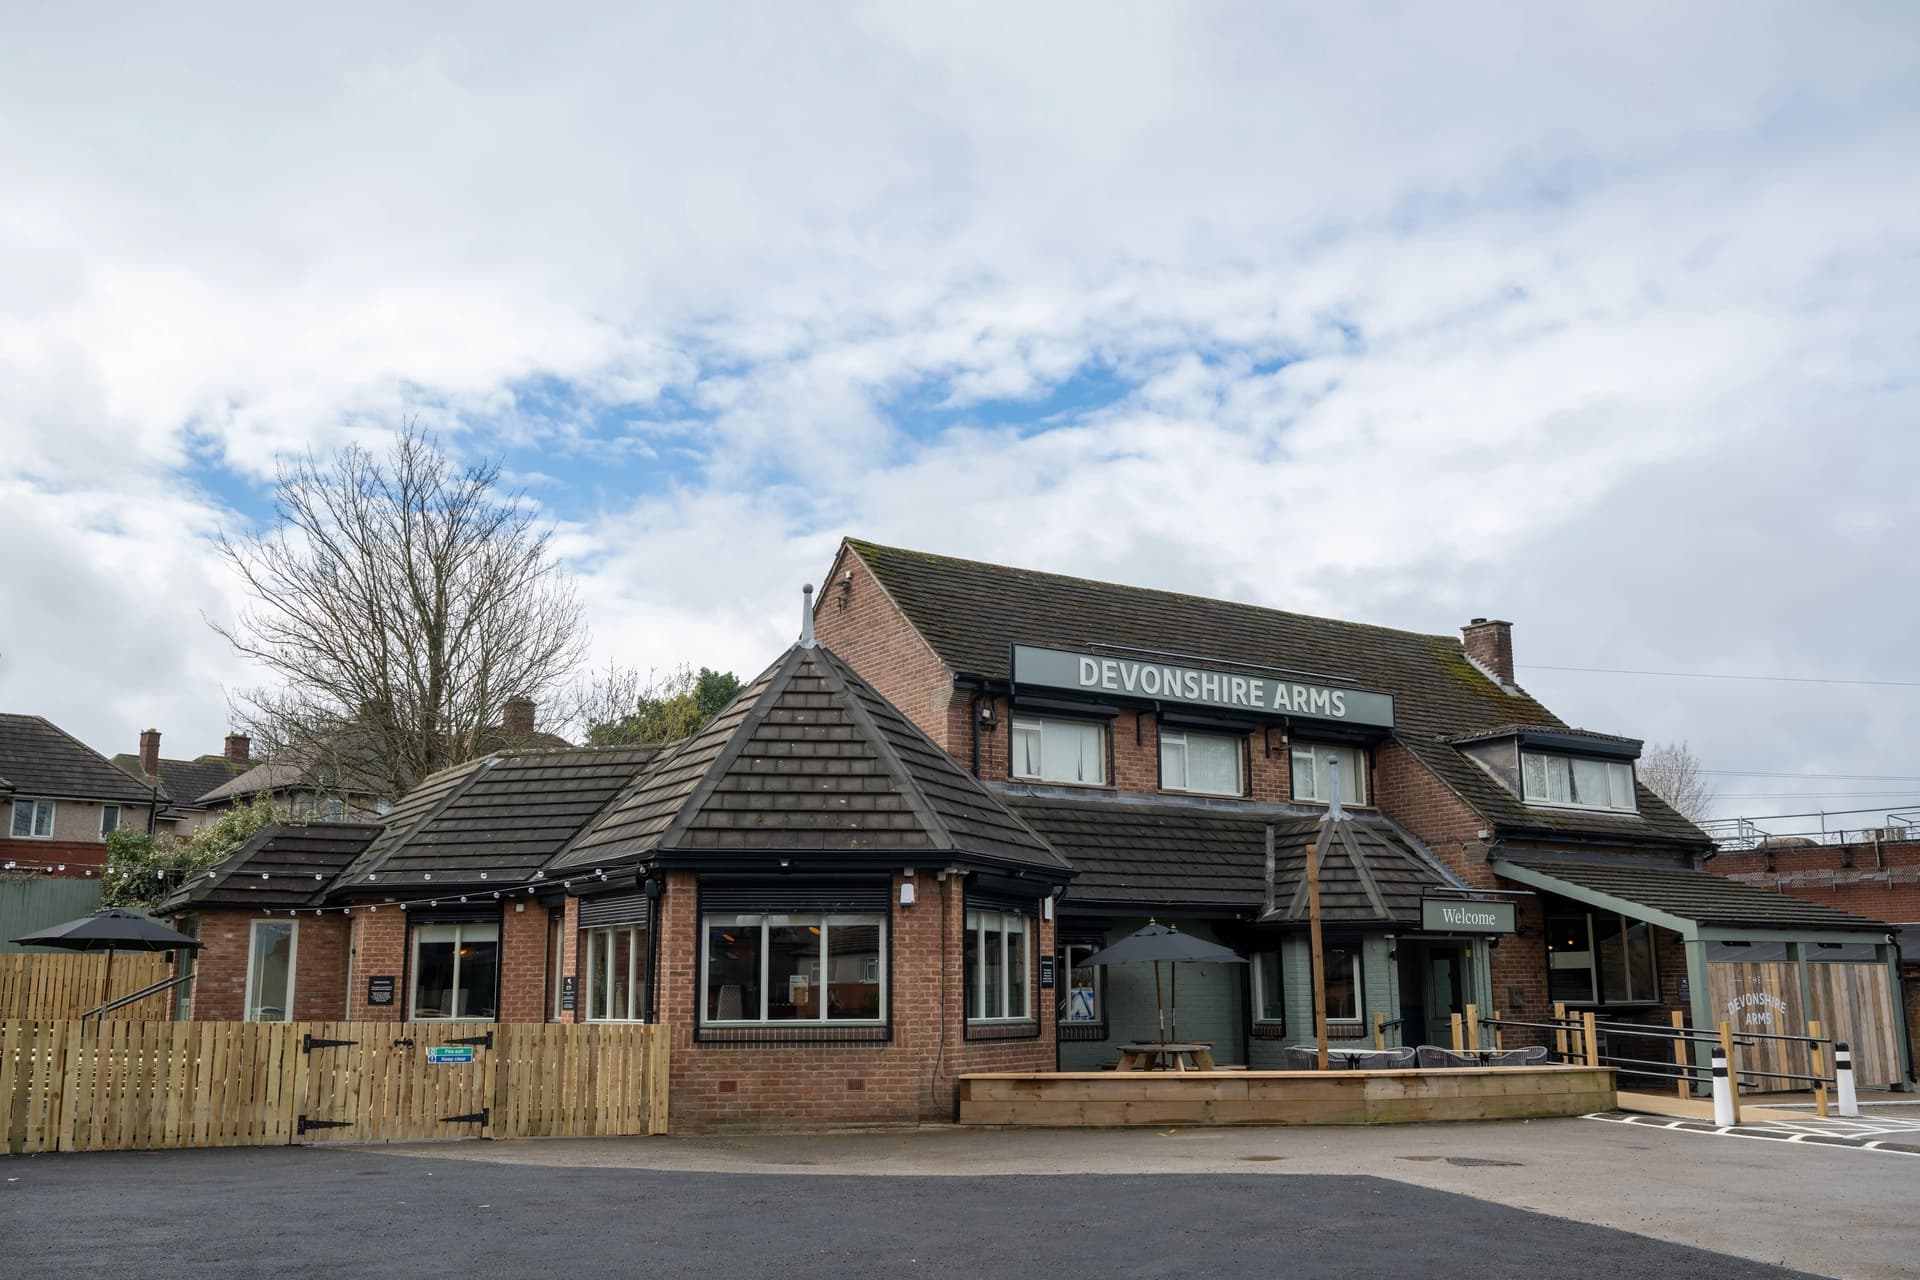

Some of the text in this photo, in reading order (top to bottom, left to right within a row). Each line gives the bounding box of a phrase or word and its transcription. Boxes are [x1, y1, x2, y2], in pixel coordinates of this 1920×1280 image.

[1079, 657, 1347, 717] DEVONSHIRE ARMS
[1441, 907, 1496, 925] Welcome
[1727, 992, 1787, 1015] DEVONSHIRE
[1745, 1012, 1772, 1025] ARMS
